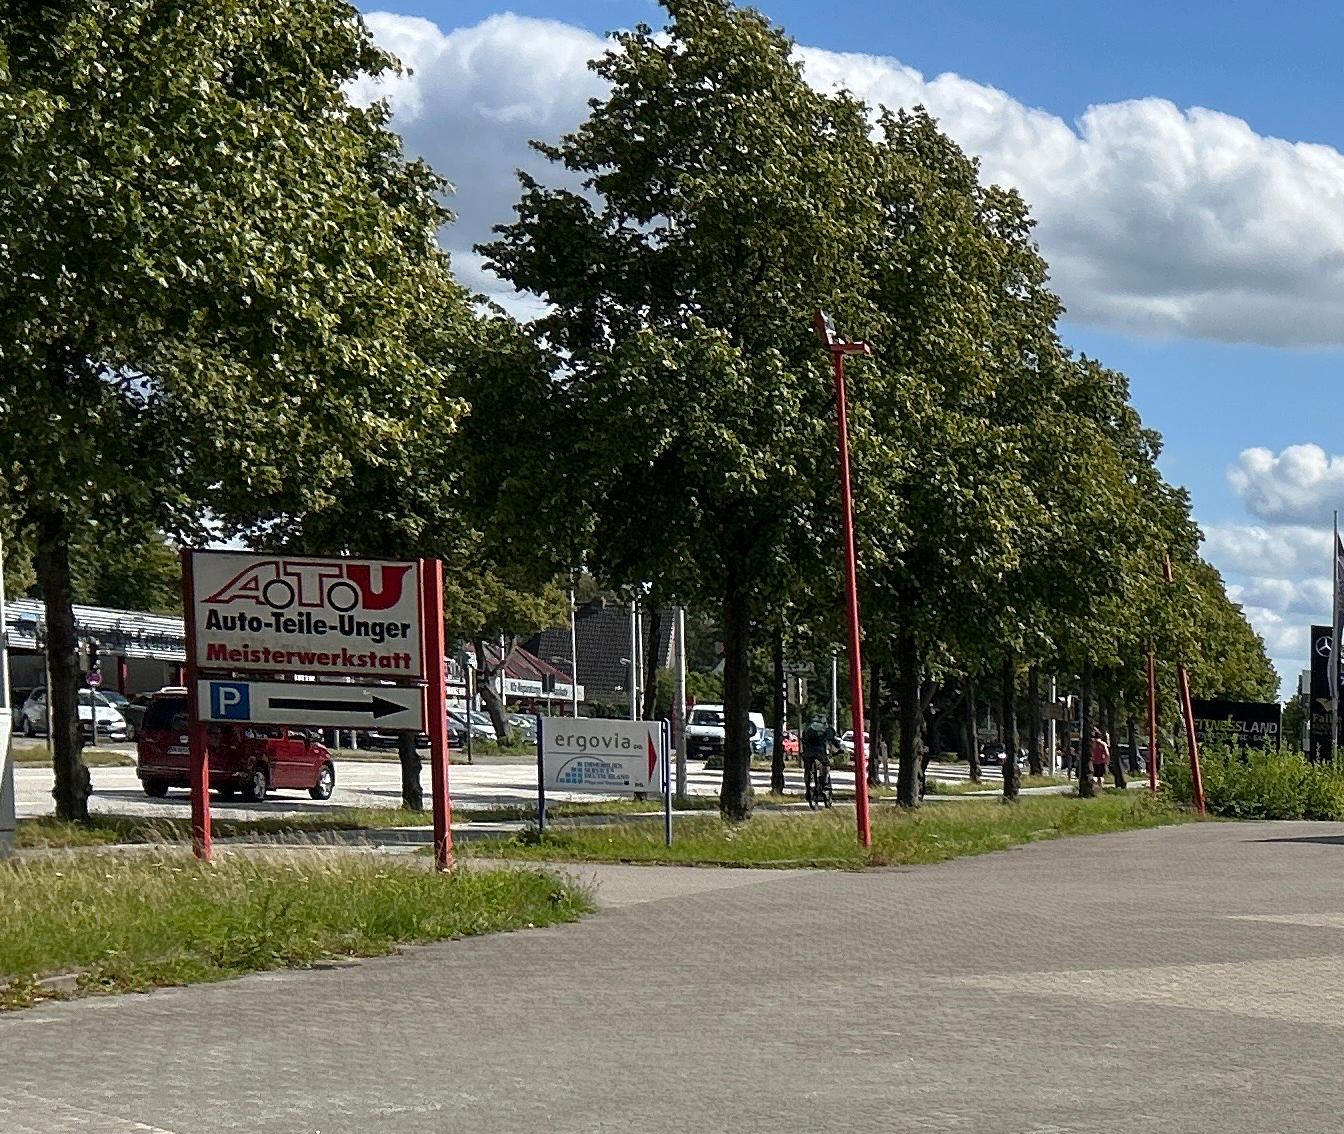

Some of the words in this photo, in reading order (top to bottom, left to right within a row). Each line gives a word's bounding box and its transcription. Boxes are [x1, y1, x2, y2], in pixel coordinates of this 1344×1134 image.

[205, 609, 411, 643] Auto-Teile-Unger
[206, 643, 412, 669] Meisterwerkstatt
[219, 686, 242, 716] P
[555, 732, 631, 752] ergovia
